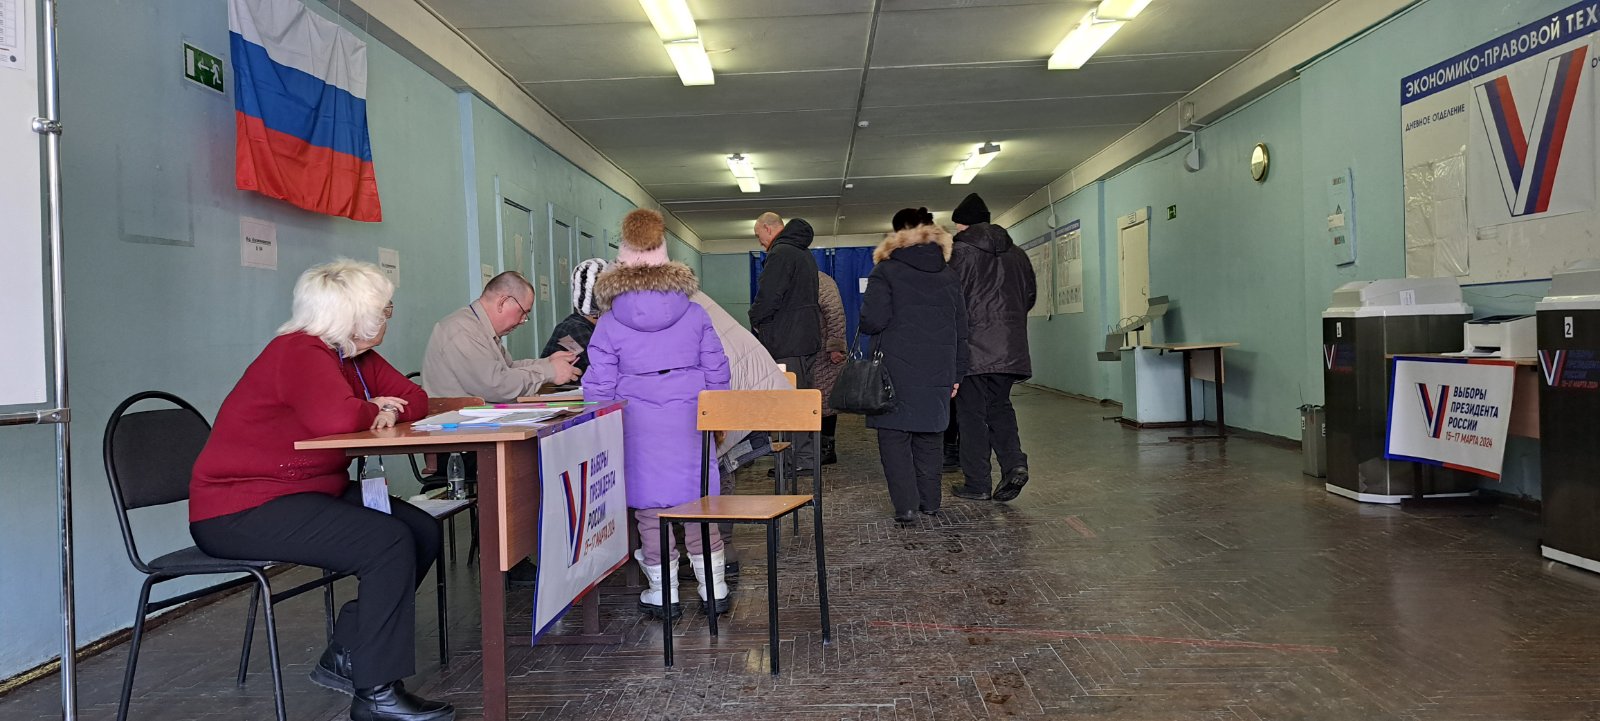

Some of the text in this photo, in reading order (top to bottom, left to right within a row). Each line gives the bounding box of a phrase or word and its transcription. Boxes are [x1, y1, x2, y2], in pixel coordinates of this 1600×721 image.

[1405, 4, 1598, 97] ЭКОНОМИКО-ПРАВОВОЙ ТЕХ
[1405, 103, 1466, 132] ДНЕВНОЕ ОТДЕЛЕНИЕ
[1565, 322, 1572, 335] 2
[1453, 386, 1488, 400] ВЫБОРЫ
[1450, 401, 1499, 419] ПРЕЗИДЕНТА
[1447, 416, 1478, 431] РОССИИ
[1460, 433, 1479, 446] МАРТА
[1479, 436, 1493, 449] 2024
[591, 450, 608, 477] ВЫБОРЫ
[590, 470, 615, 504] ПРЕЗИДЕНТА
[587, 502, 606, 532] РОССИИ
